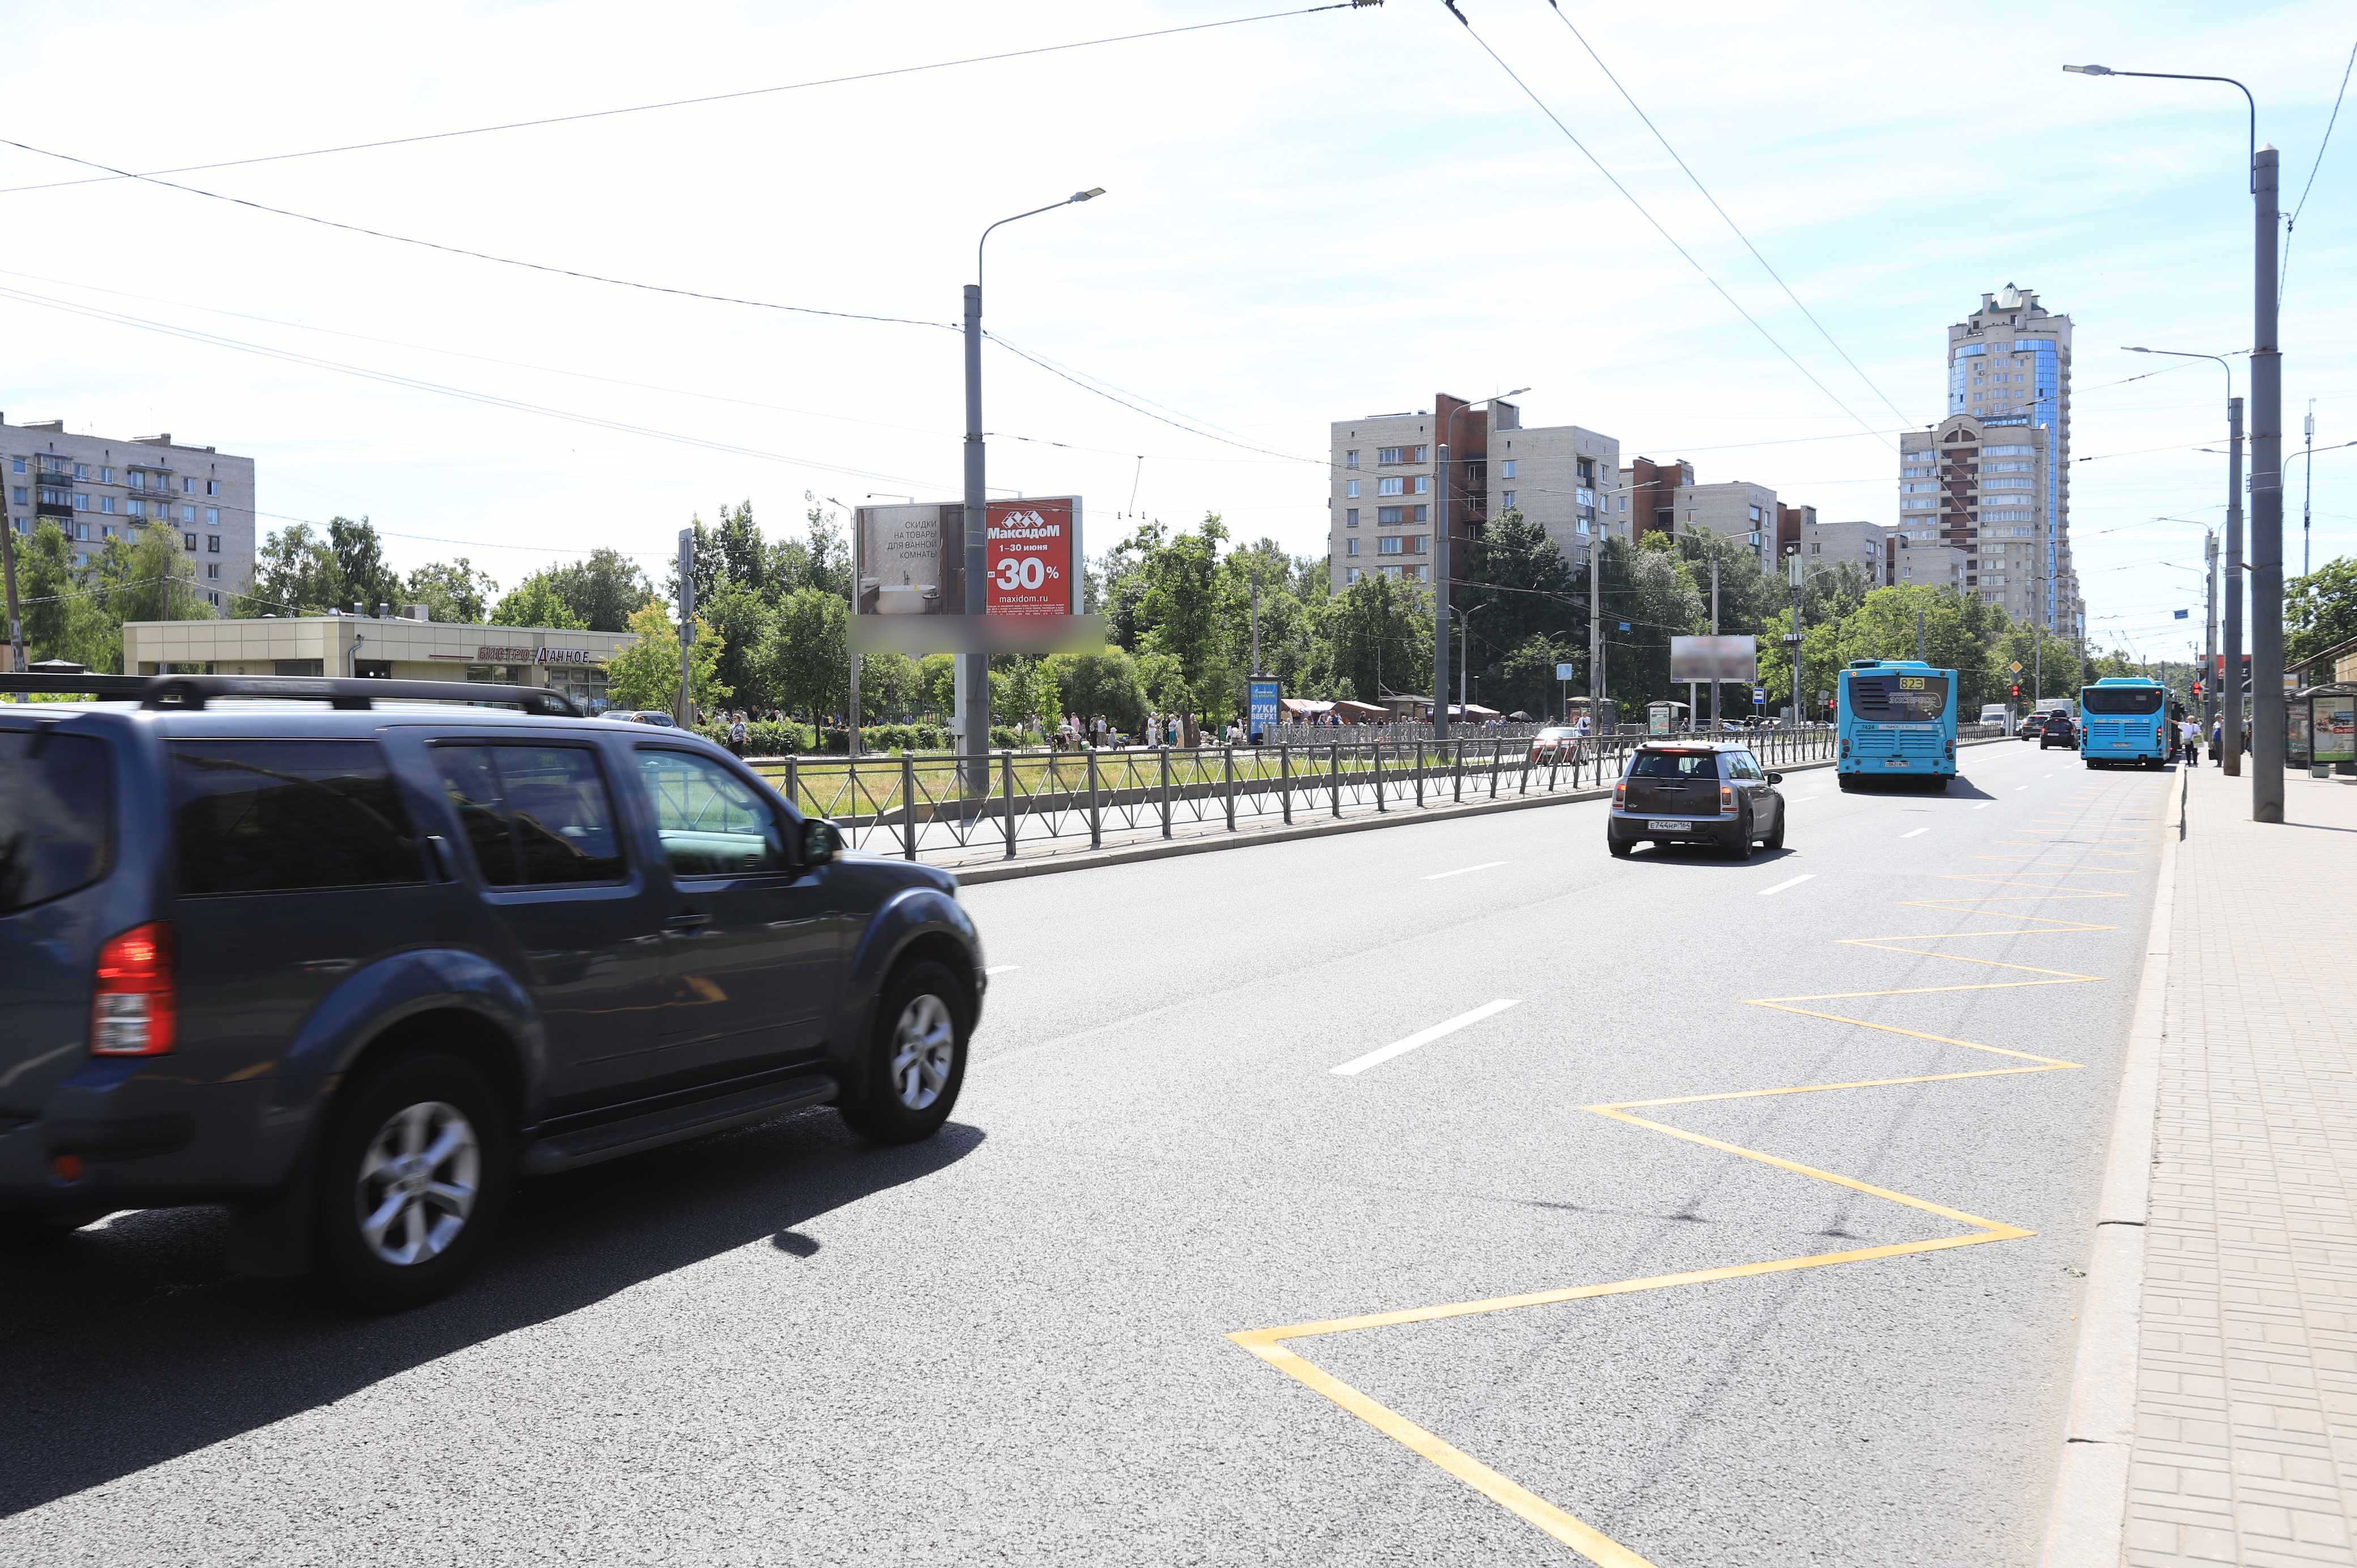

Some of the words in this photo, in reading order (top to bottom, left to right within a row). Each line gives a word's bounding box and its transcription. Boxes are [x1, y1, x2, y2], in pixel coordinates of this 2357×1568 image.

[906, 540, 937, 548] ВАННОЙ
[478, 647, 530, 661] БИСТРО
[535, 647, 589, 664] ДАЧНОЕ
[1901, 679, 1923, 689] 82Э
[1252, 704, 1277, 713] РУКИ
